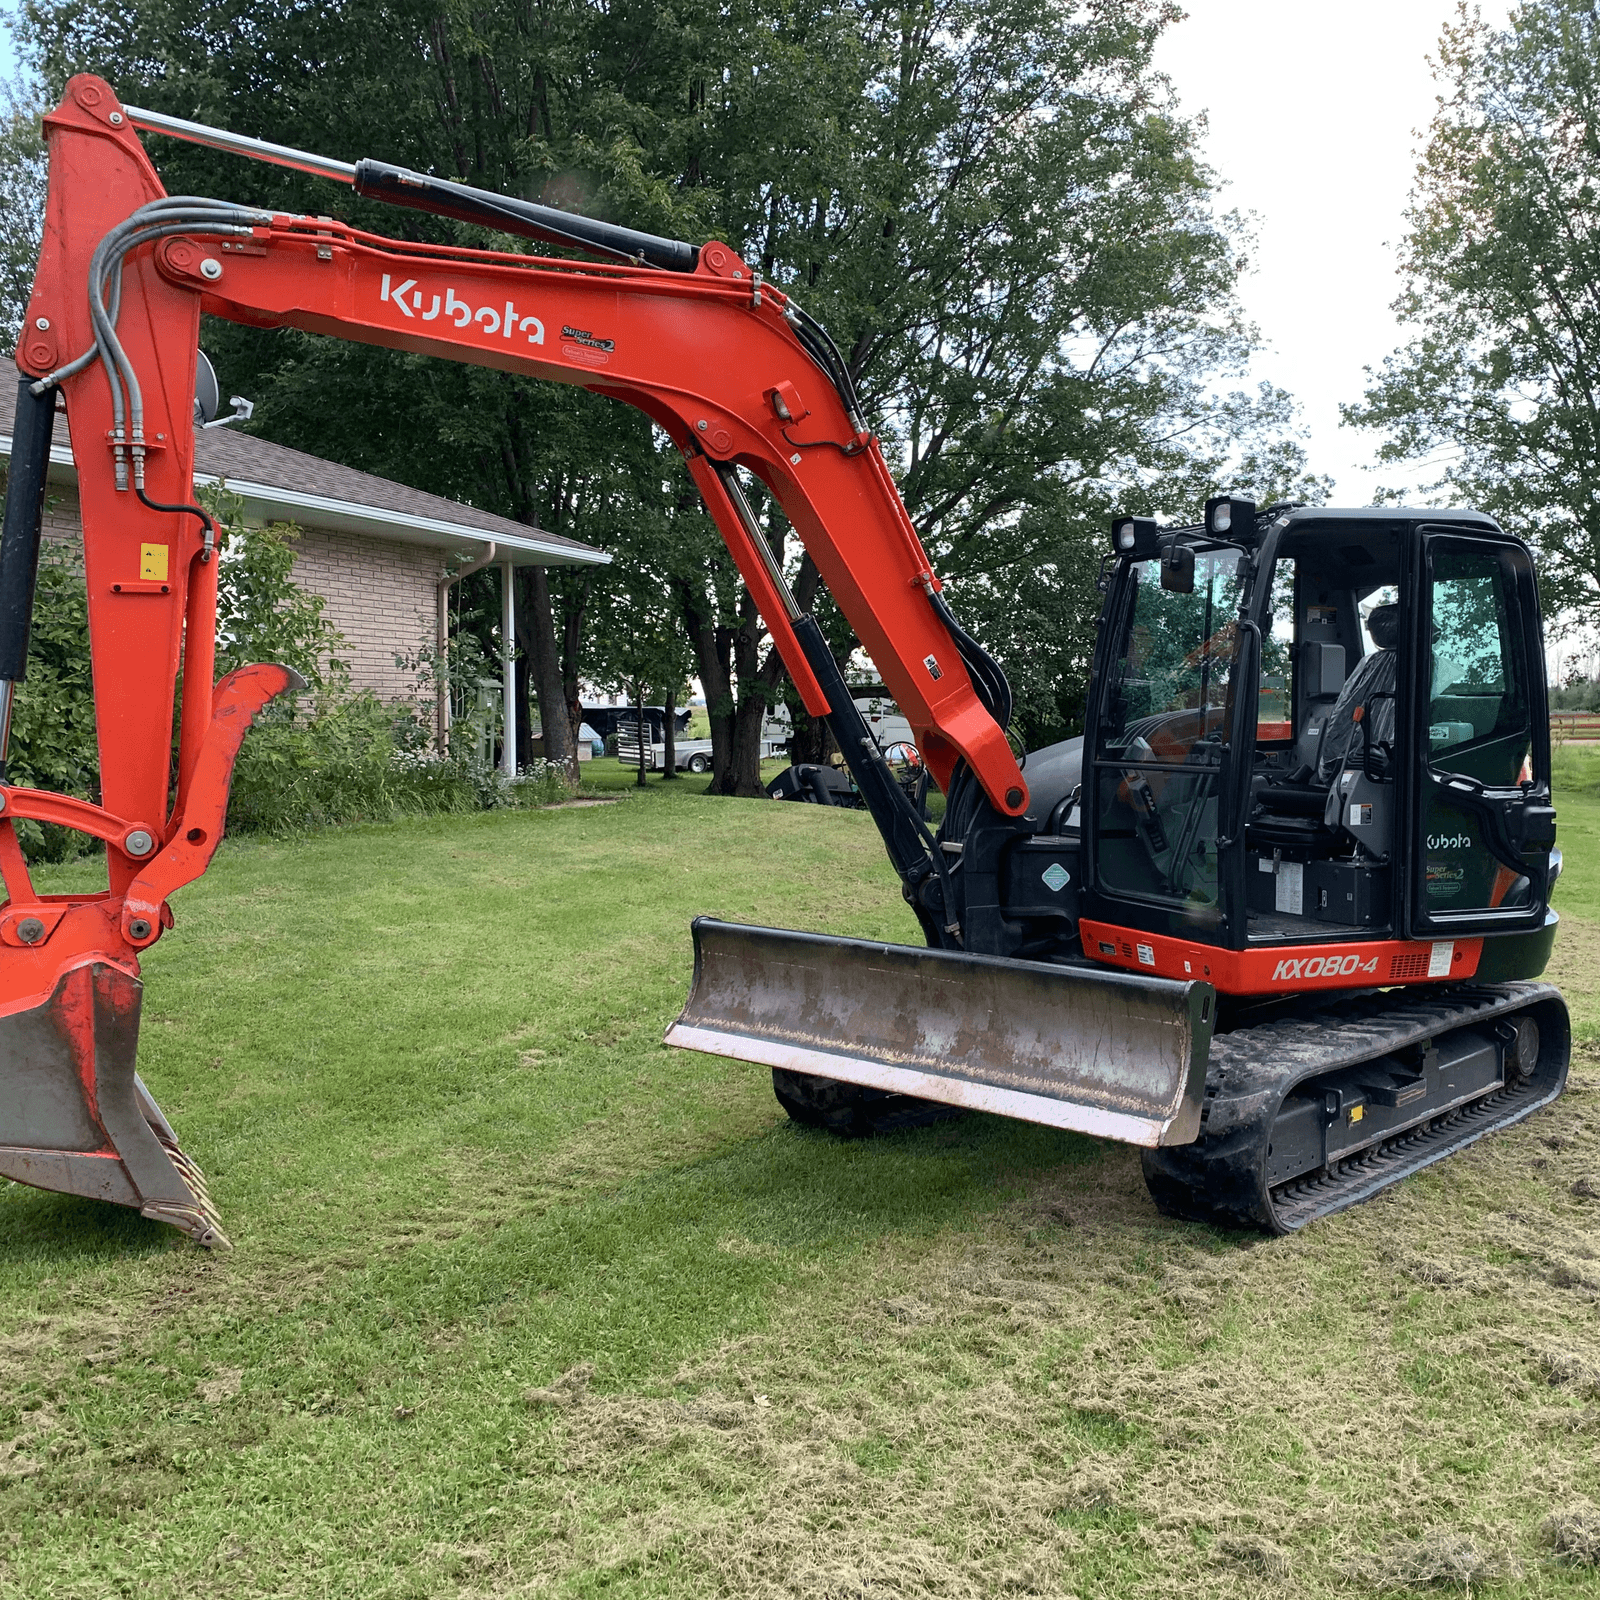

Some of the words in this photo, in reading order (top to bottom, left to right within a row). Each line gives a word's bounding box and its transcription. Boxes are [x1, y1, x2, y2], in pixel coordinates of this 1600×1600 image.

[380, 273, 545, 346] Kubota
[562, 325, 592, 338] Super
[1426, 865, 1447, 875] Super
[1271, 954, 1379, 981] KX080-4
